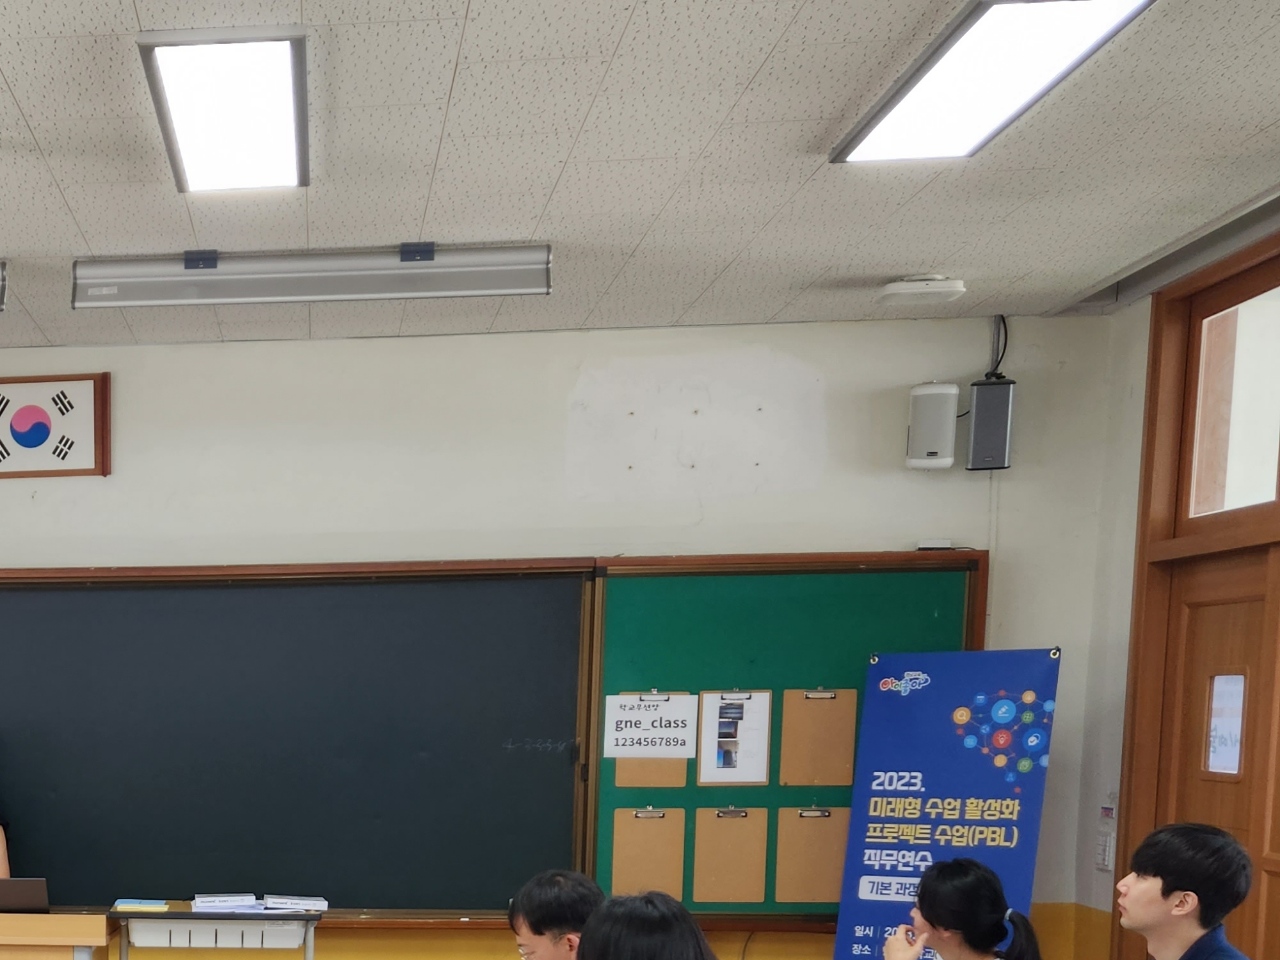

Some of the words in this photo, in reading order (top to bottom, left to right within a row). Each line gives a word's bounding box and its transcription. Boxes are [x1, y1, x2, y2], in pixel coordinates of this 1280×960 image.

[615, 716, 688, 732] gne_class
[614, 737, 687, 747] 123456789a
[871, 771, 926, 792] 2023.
[868, 797, 922, 819] 미래형
[925, 798, 962, 819] 수업
[964, 797, 1021, 820] 활성화
[865, 823, 932, 844] 프로젝트
[934, 824, 1019, 848] 수업(PBL)
[863, 849, 933, 872] 직무연수
[868, 881, 892, 896] 기본
[854, 925, 874, 938] 일시
[851, 944, 871, 955] 장소
